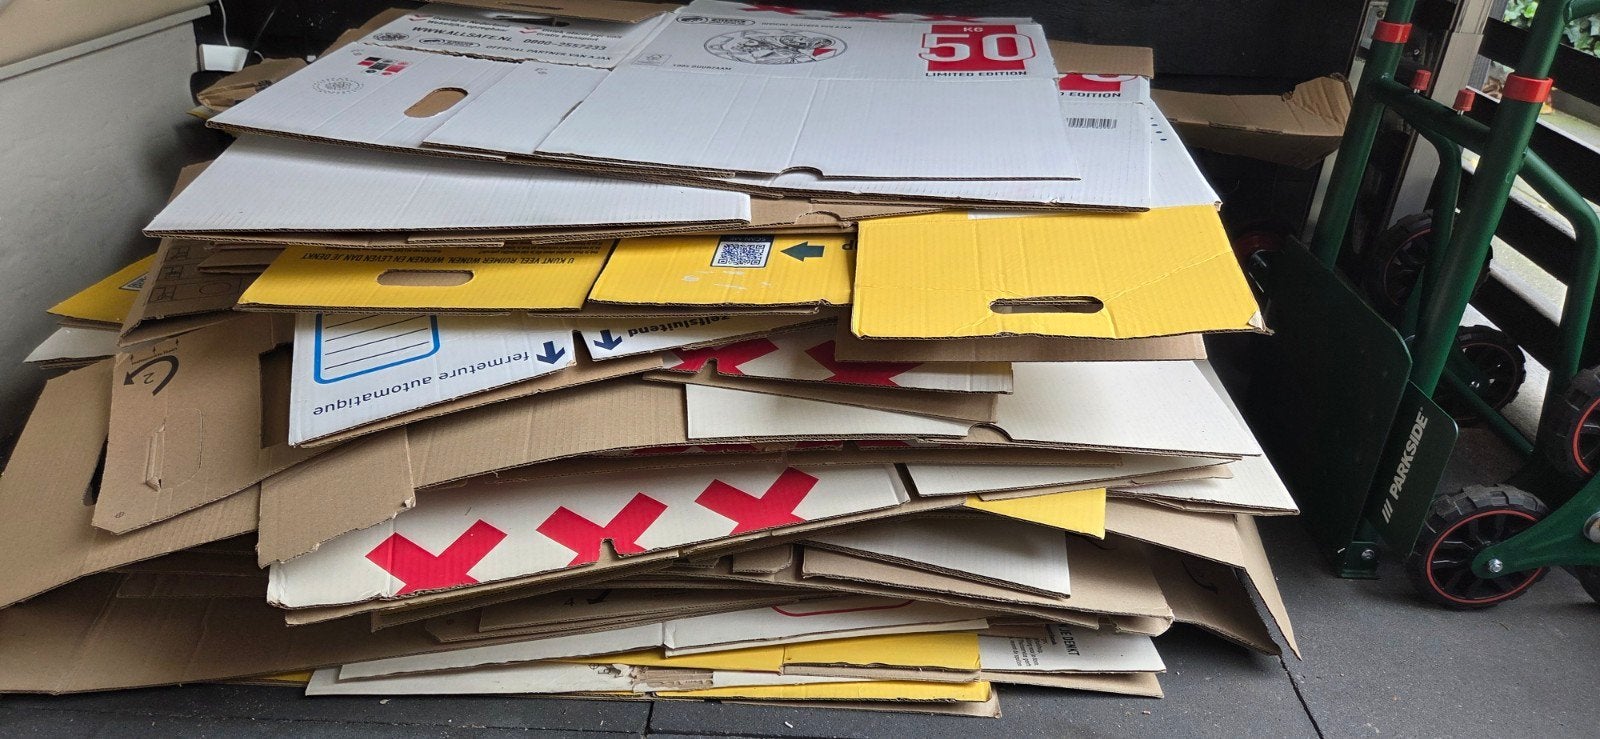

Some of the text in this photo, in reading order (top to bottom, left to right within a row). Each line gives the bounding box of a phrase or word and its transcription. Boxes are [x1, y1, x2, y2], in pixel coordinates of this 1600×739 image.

[412, 26, 513, 42] WWW.ALLSAFE.NL
[523, 38, 607, 50] 0800-2557233
[918, 32, 1036, 62] 50
[301, 252, 330, 261] DENKT
[342, 254, 362, 262] DAN
[363, 254, 393, 262] LEVEN
[407, 256, 445, 264] WERKEN
[313, 351, 529, 416] fermeture automatique
[1389, 407, 1429, 501] PARKSIDE
[1062, 636, 1080, 656] DENKT
